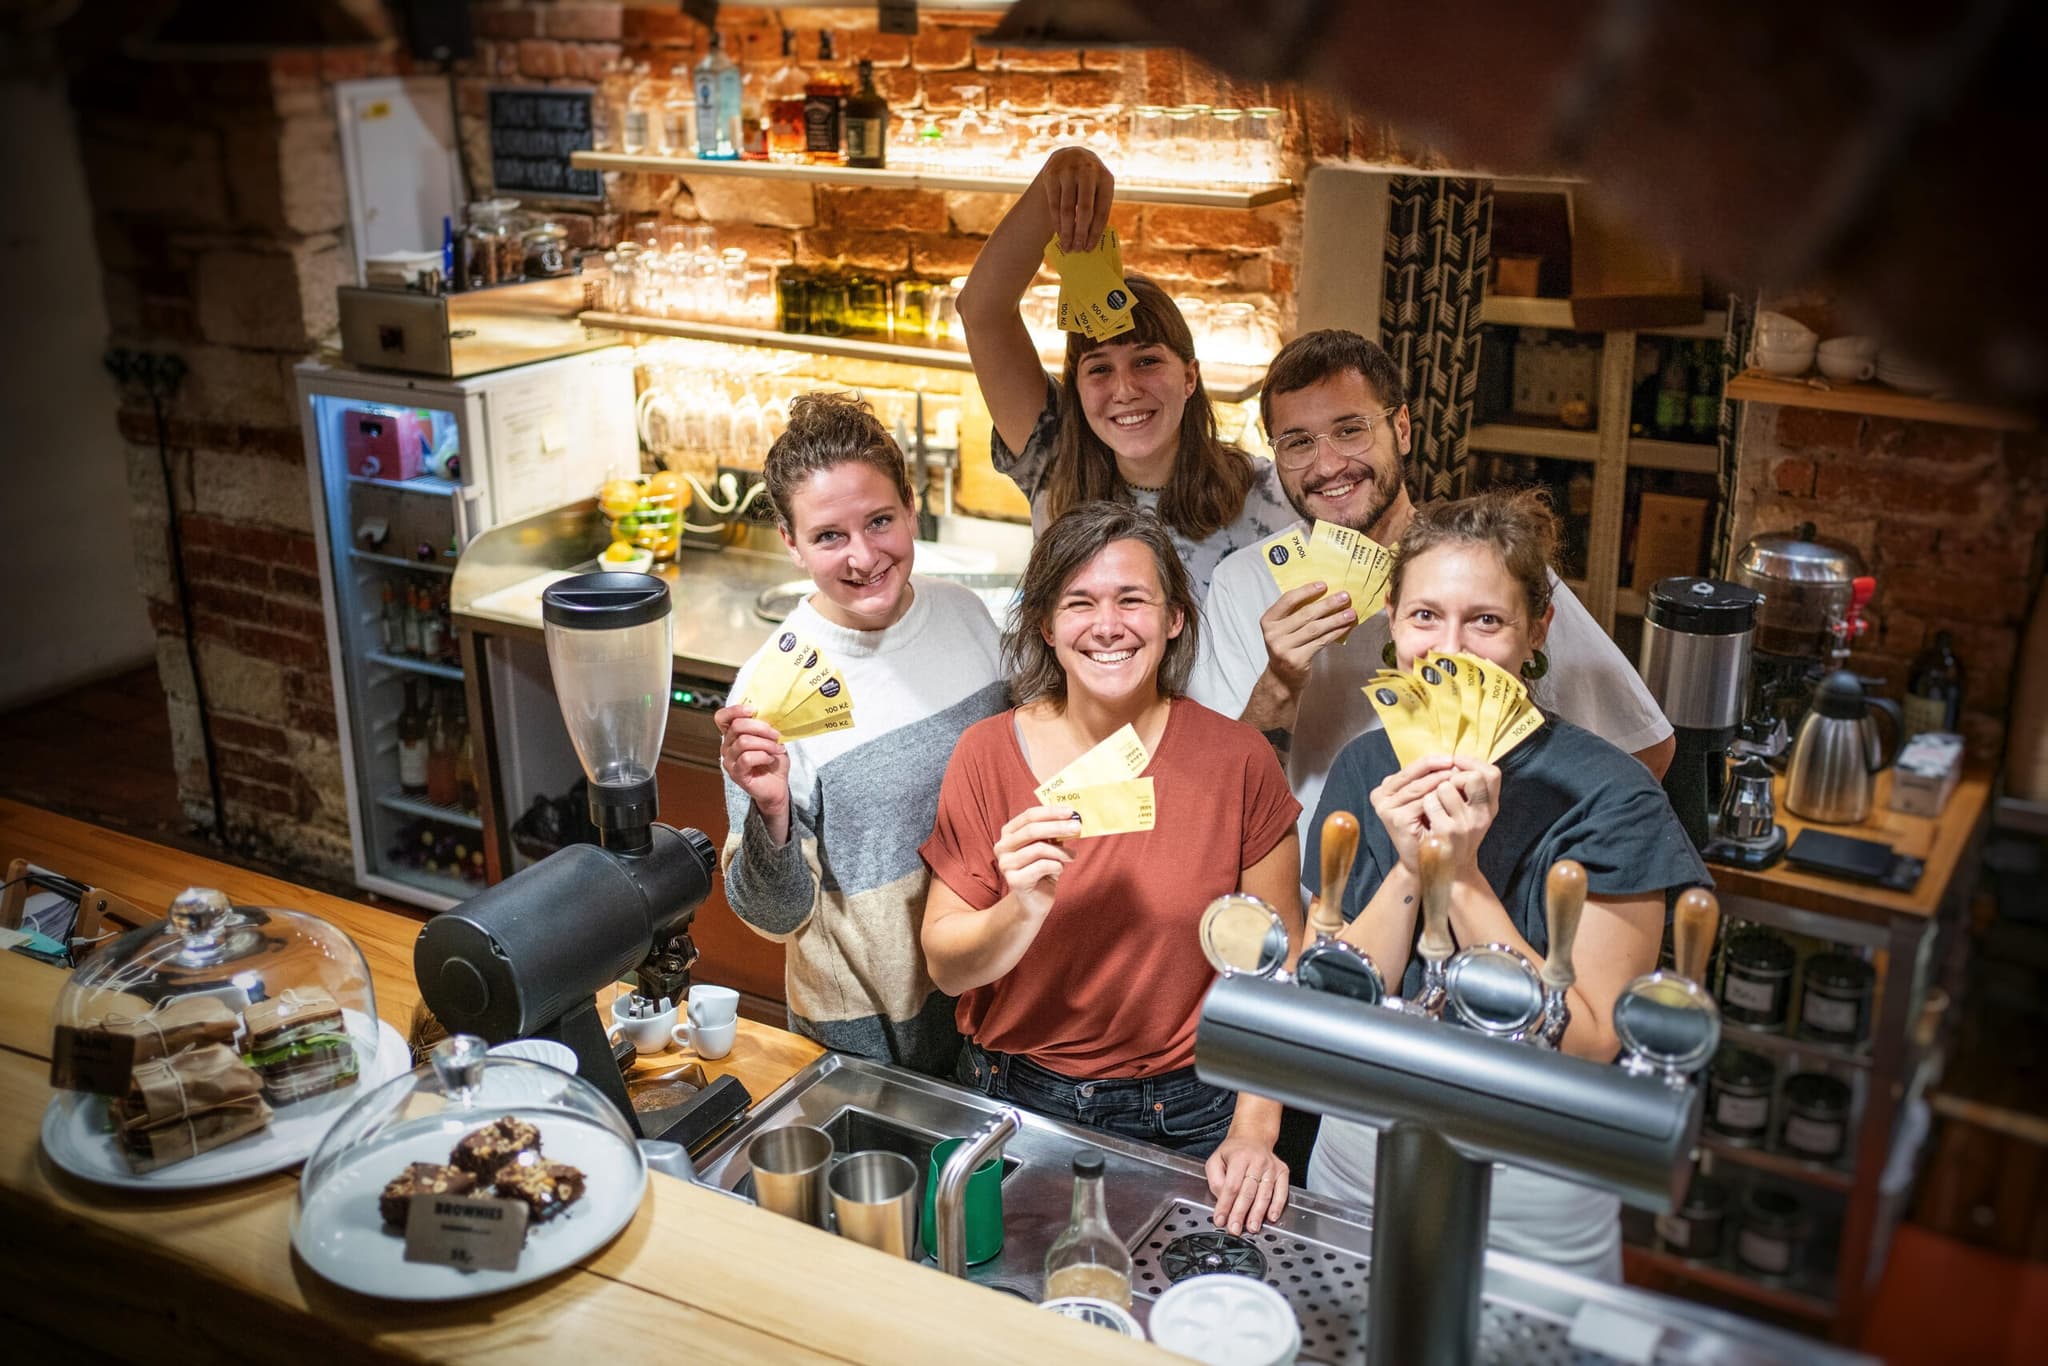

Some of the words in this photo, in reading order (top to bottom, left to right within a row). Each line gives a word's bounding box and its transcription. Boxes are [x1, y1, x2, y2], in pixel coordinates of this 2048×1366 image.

[1091, 303, 1101, 316] 100
[1080, 312, 1088, 326] 100
[1296, 546, 1307, 559] 100
[794, 654, 804, 666] 100
[809, 674, 822, 687] 100
[1491, 684, 1501, 698] 100
[824, 706, 838, 715] 100
[824, 721, 838, 729] 100
[1512, 723, 1527, 737] 100
[1067, 792, 1081, 800] 100
[435, 1202, 503, 1221] BROWNIES
